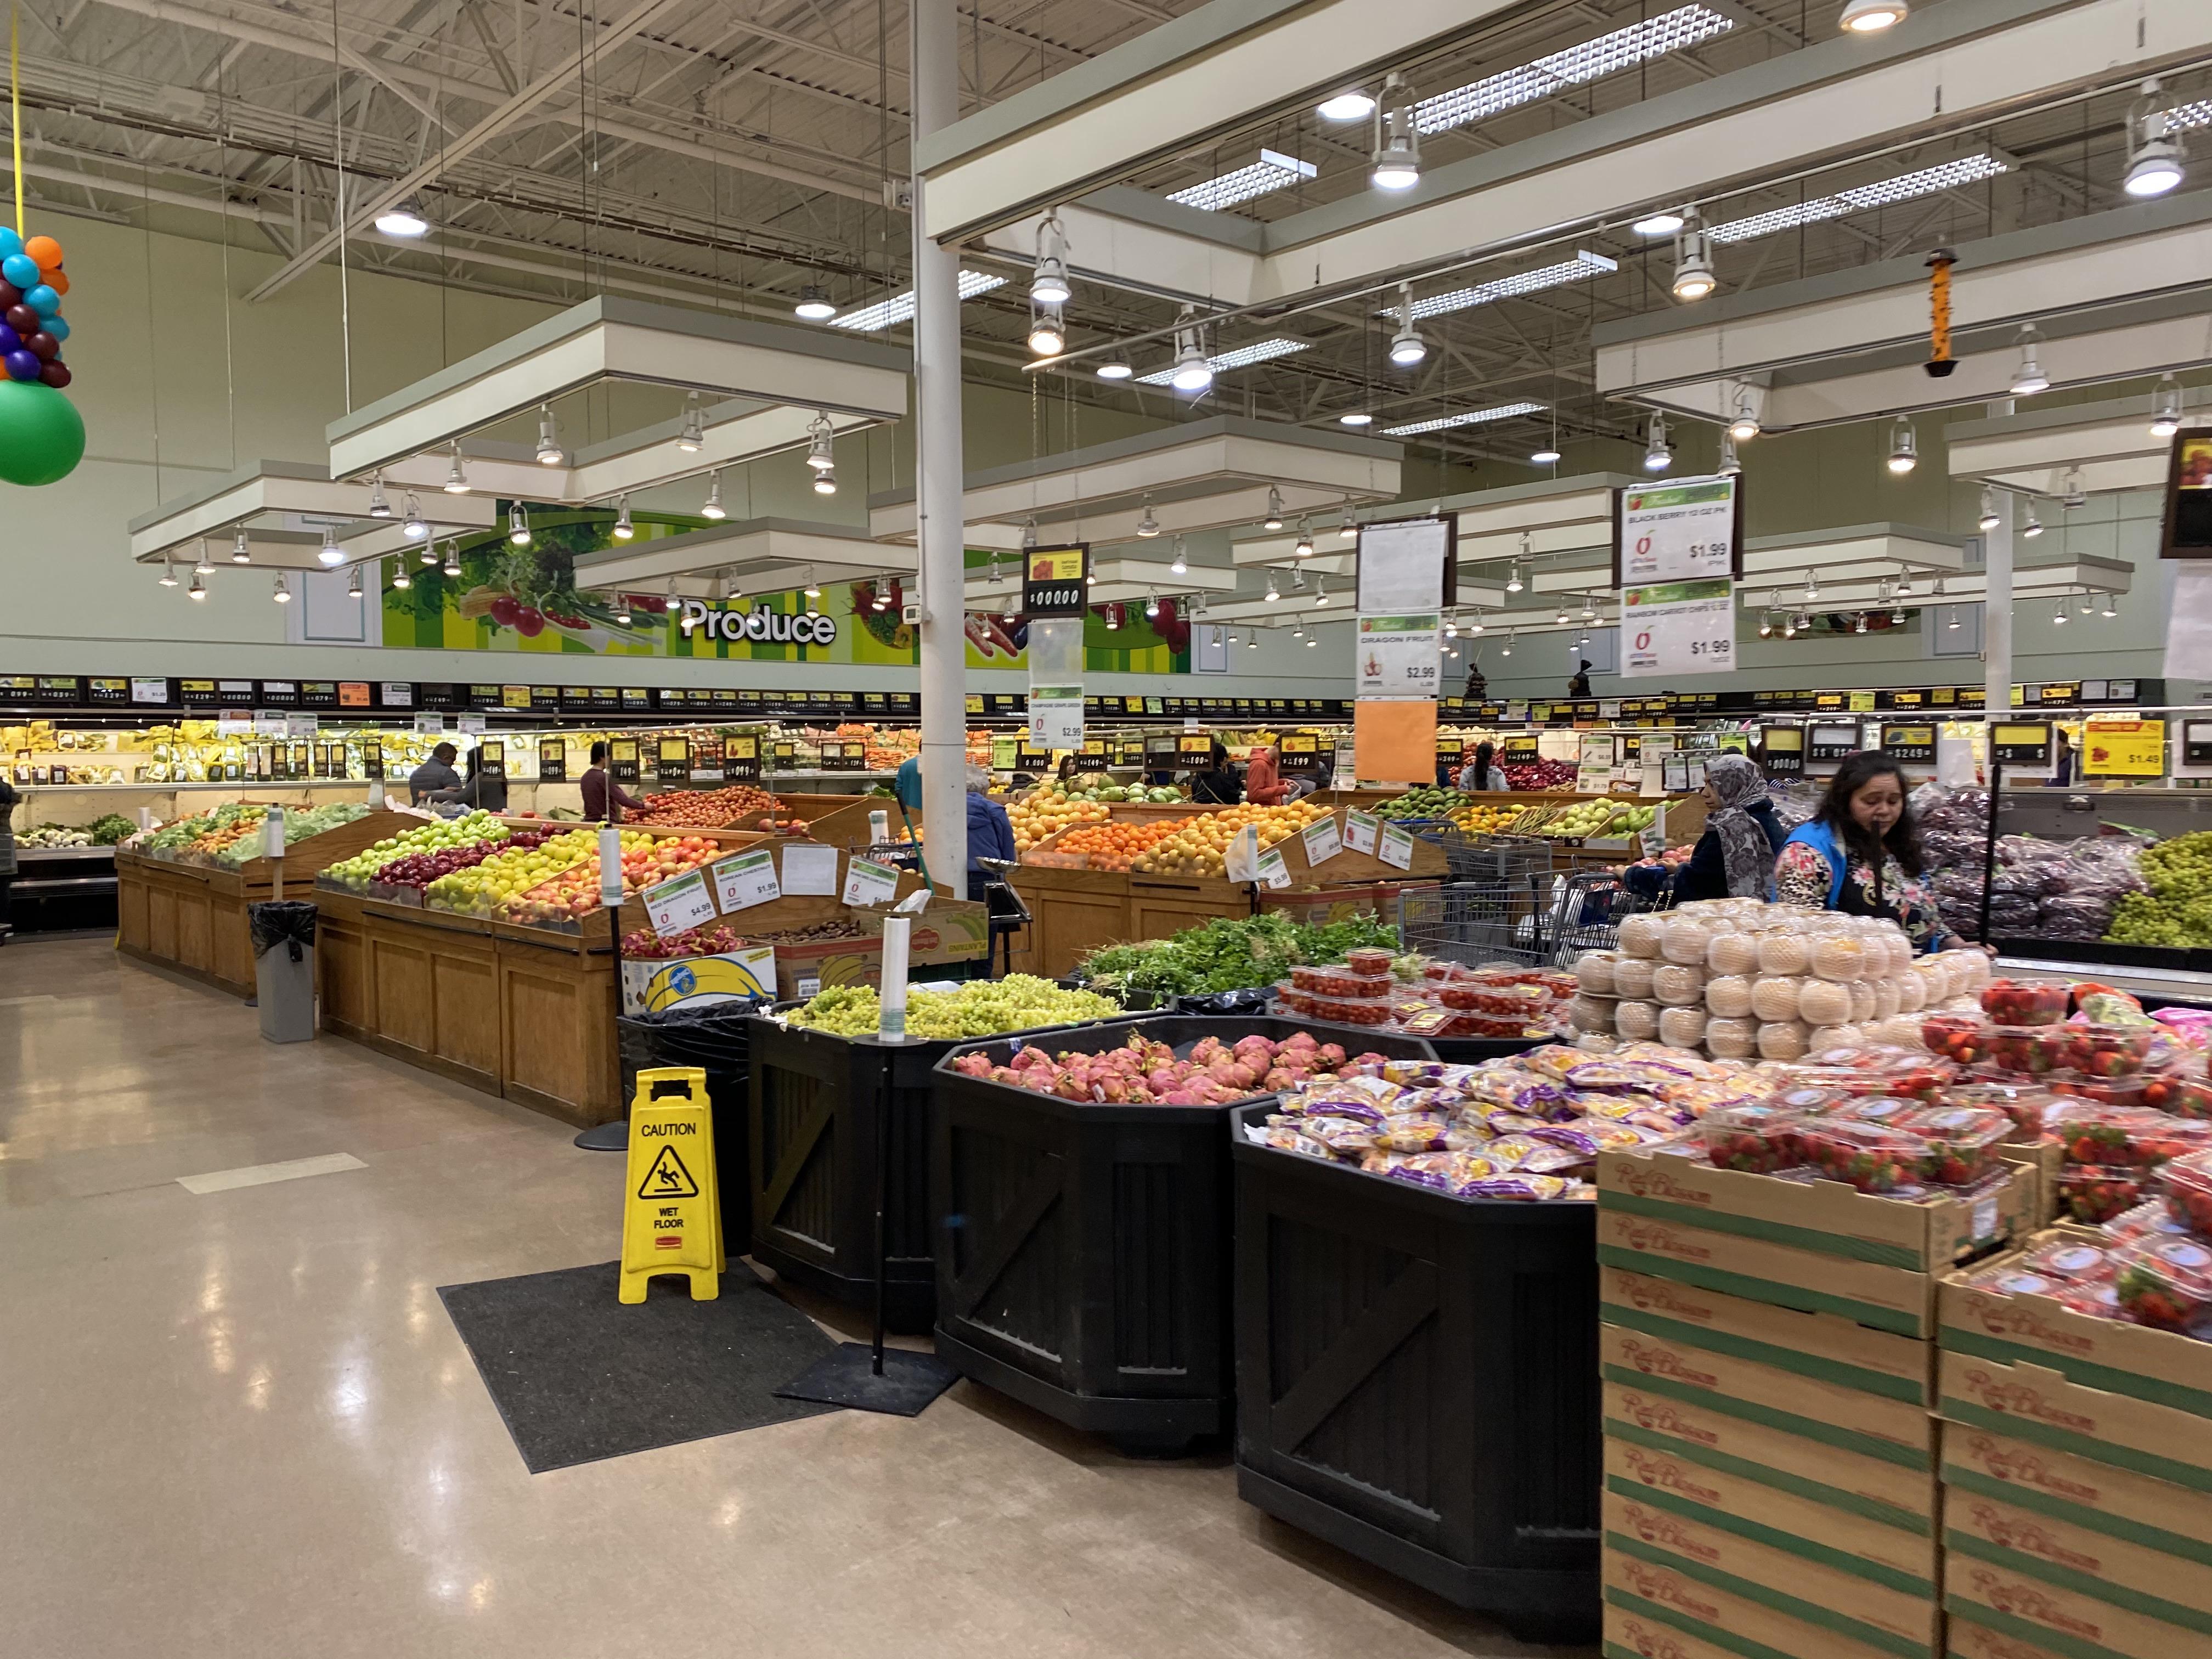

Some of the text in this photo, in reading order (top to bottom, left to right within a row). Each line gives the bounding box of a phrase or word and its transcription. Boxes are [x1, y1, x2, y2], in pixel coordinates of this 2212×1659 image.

[1690, 543, 1727, 557] $1.99
[683, 601, 836, 644] Produce
[1691, 640, 1730, 654] $1.99
[1407, 667, 1435, 678] $2.99
[1063, 727, 1081, 736] $2.99
[2128, 755, 2159, 763] $1.49
[719, 865, 771, 882] KOREAN CHESTNUT
[757, 882, 776, 893] $1.99
[663, 893, 686, 905] DRAGON
[687, 885, 702, 894] FRUIT
[691, 902, 711, 916] $4.99
[641, 1122, 696, 1137] CAUTION
[659, 1207, 679, 1216] WET
[654, 1219, 684, 1229] FLOOR
